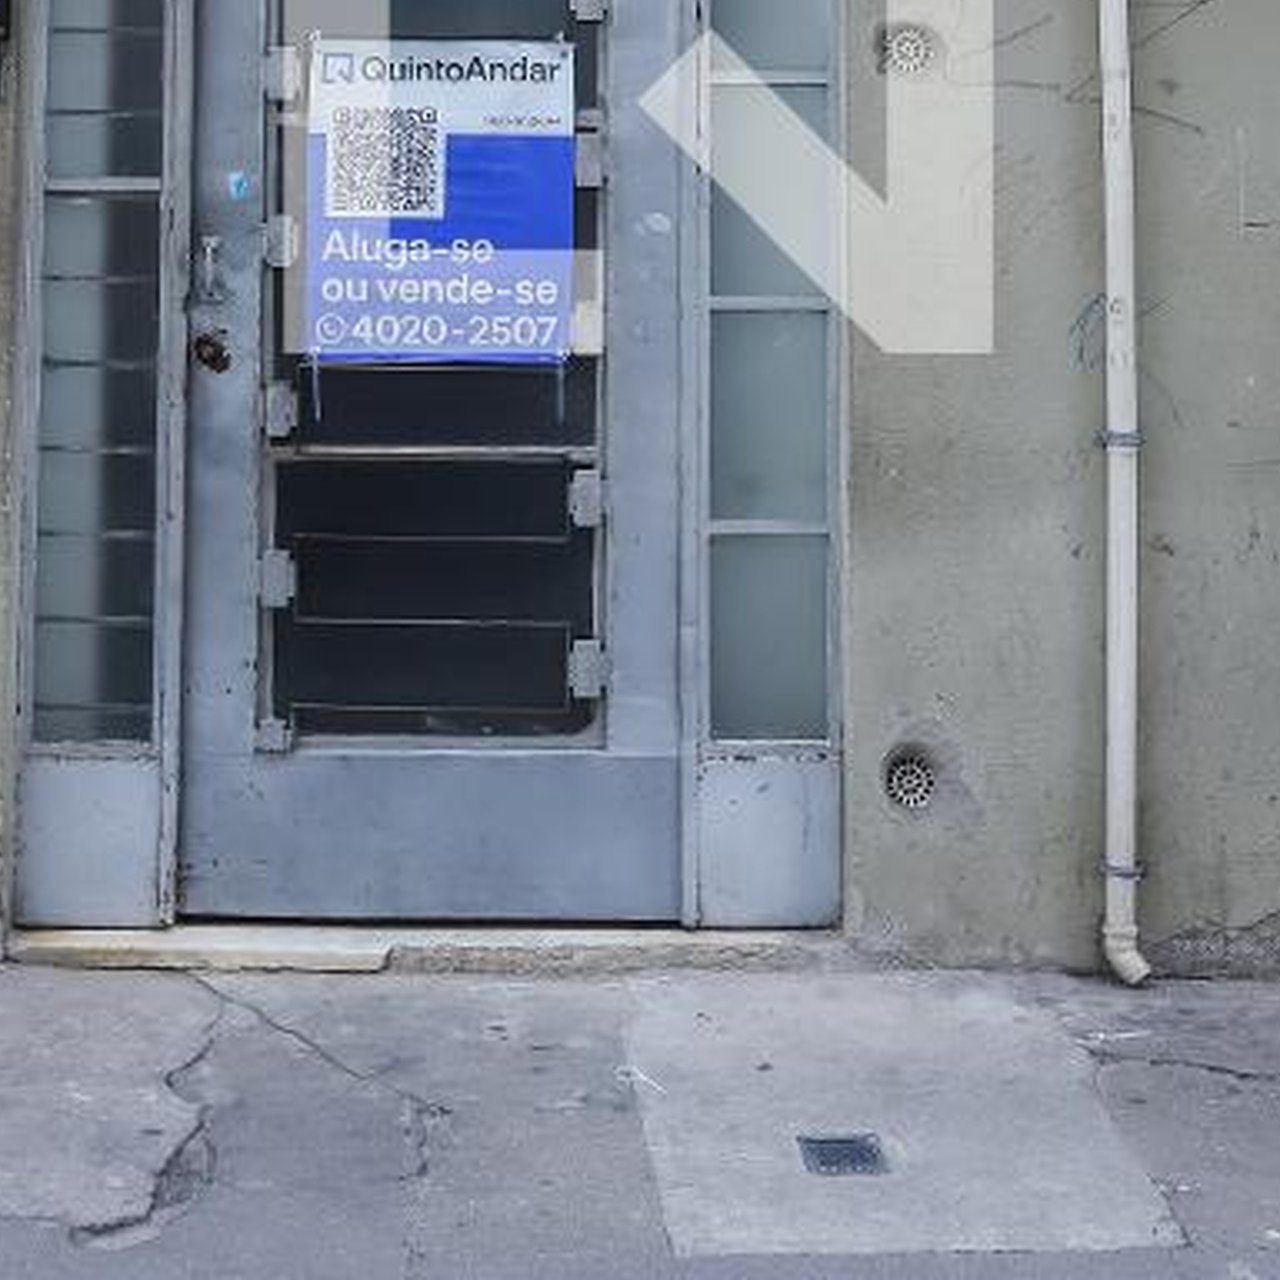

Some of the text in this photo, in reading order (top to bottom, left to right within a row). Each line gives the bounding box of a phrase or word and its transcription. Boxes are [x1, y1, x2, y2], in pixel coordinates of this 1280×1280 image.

[363, 55, 561, 83] QuintoAndar
[322, 229, 495, 270] Aluga-se
[322, 273, 559, 305] ou vende-se
[352, 316, 558, 345] 4020-2507
